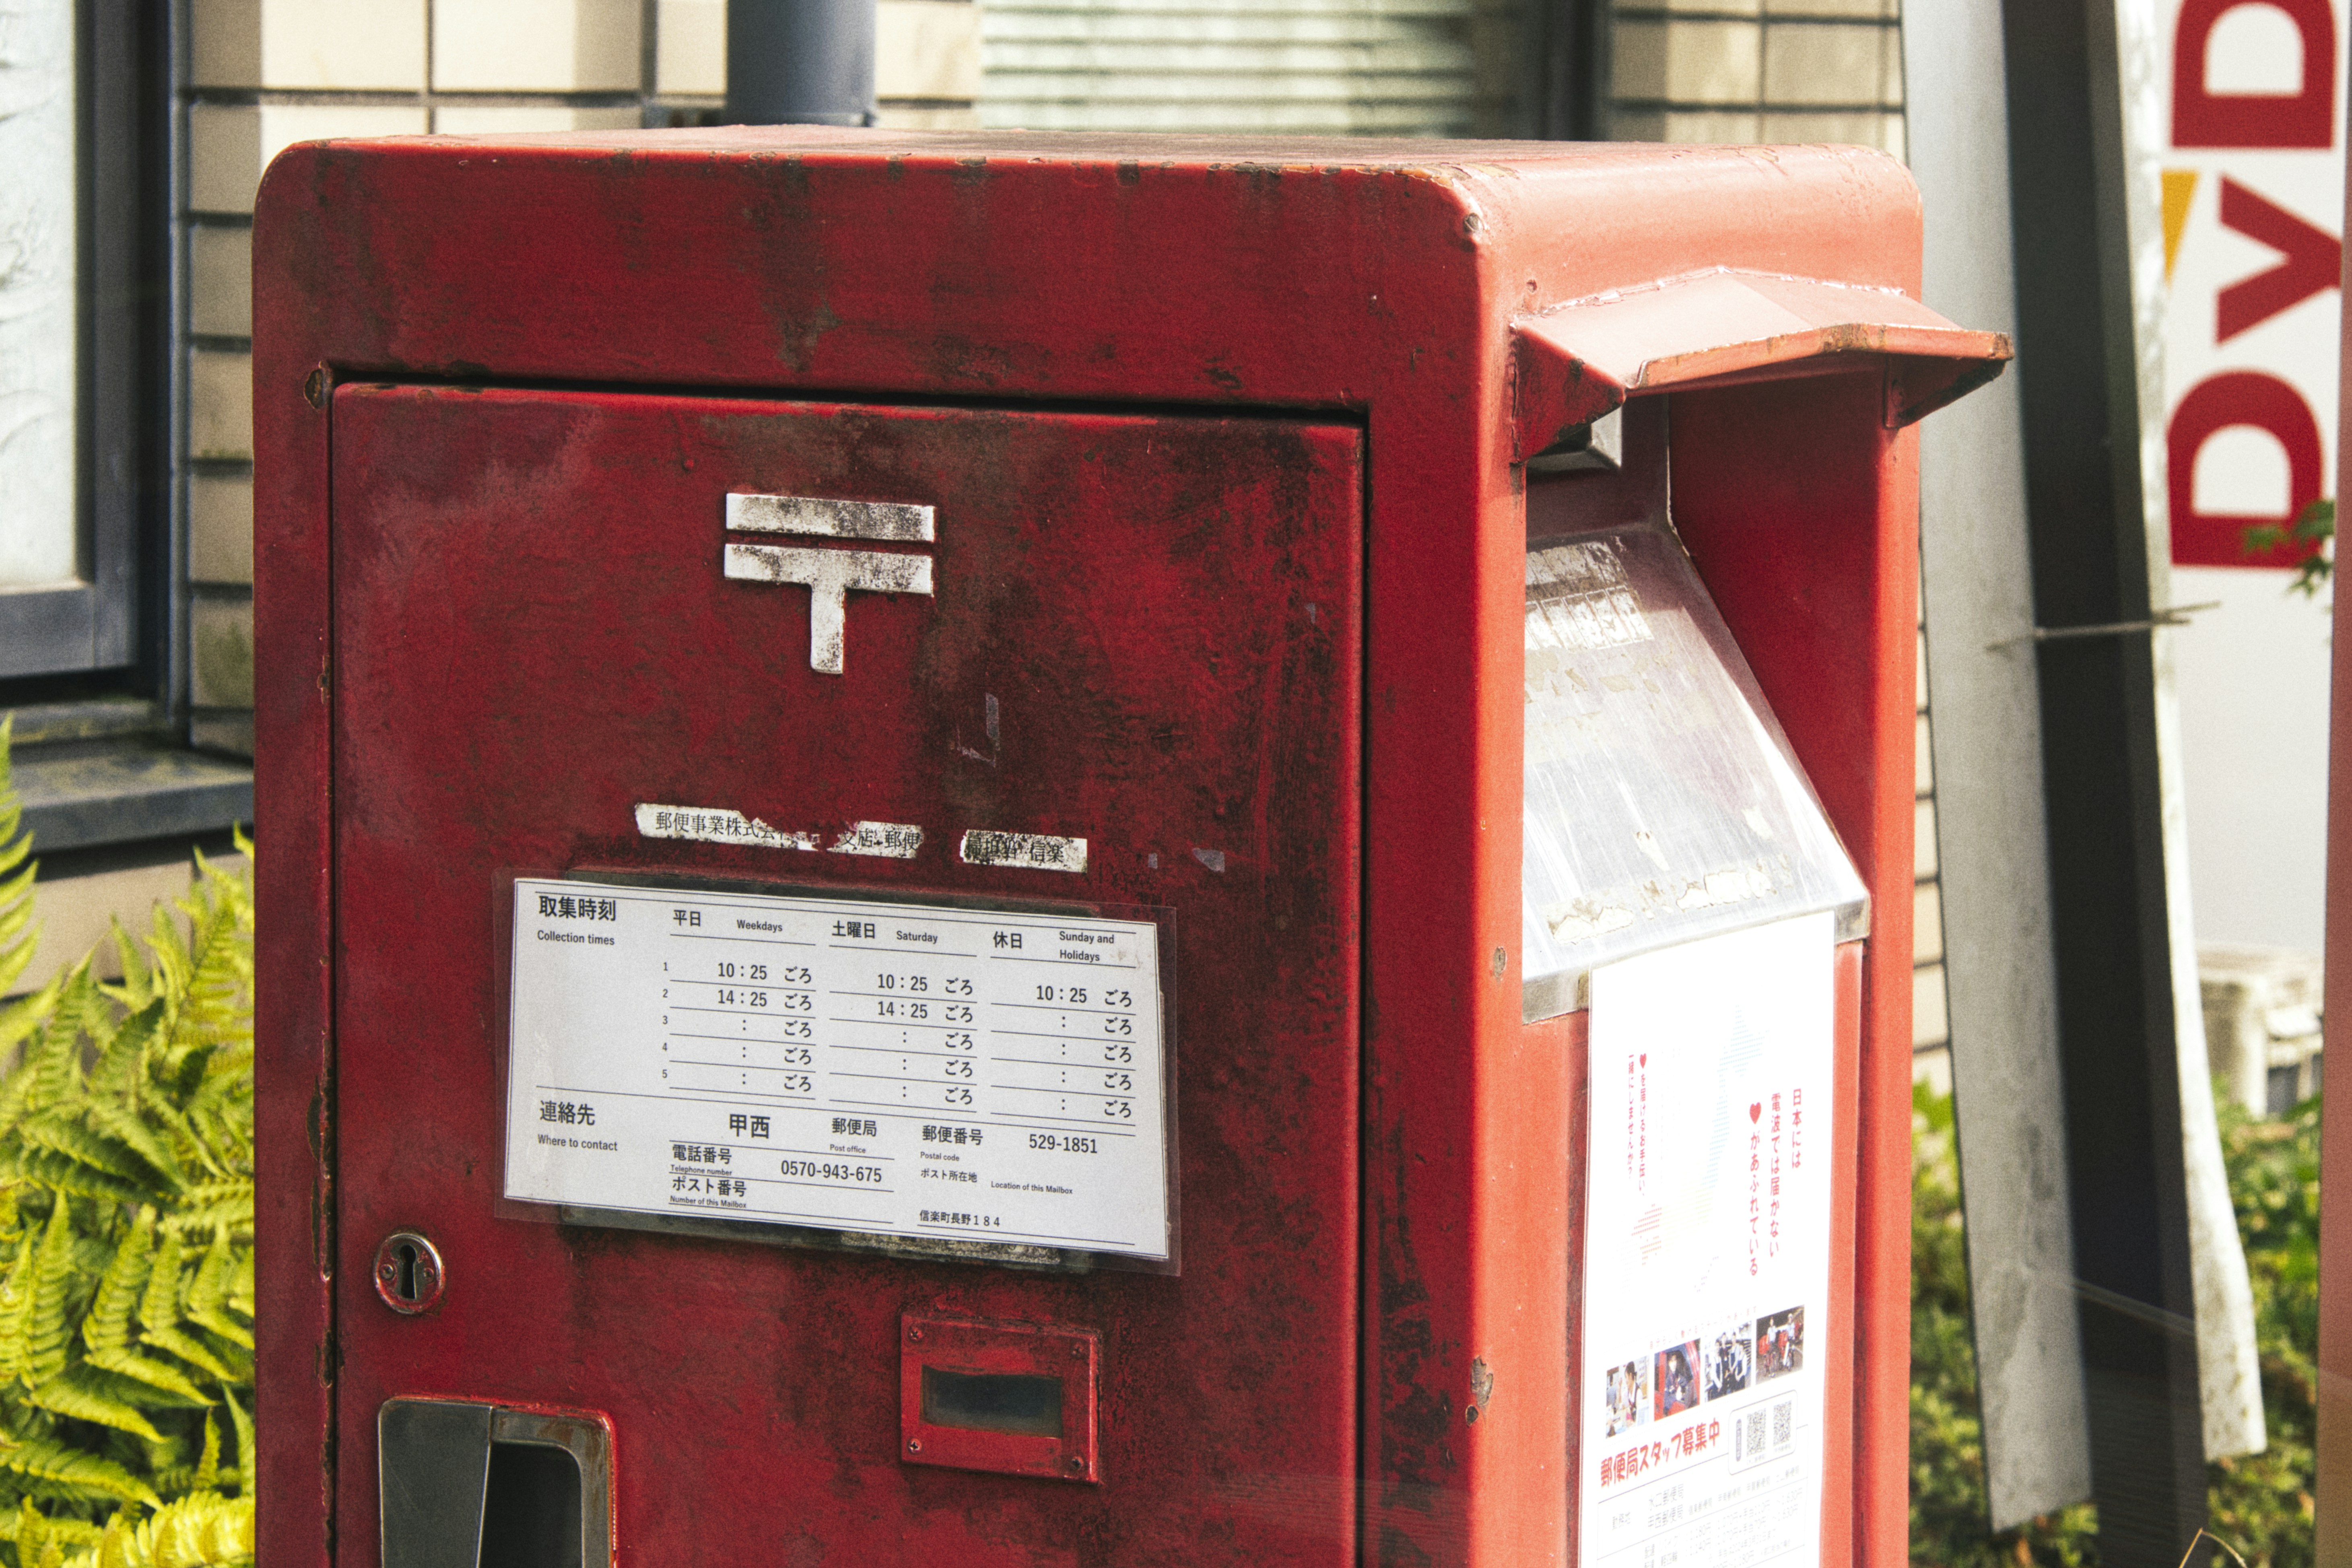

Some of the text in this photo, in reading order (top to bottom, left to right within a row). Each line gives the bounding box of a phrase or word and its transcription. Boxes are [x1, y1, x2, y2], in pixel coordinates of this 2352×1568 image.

[884, 829, 920, 851] 郵便
[1030, 842, 1064, 863] 信楽
[538, 895, 616, 921] 取集時刻
[673, 910, 701, 927] 平日
[737, 920, 783, 933] Weekdays
[537, 930, 614, 945] Collection times
[832, 920, 875, 939] 土曜日
[896, 930, 938, 944] Saturday
[1060, 931, 1114, 944] Sunday and
[993, 931, 1022, 949] 休日
[1060, 950, 1100, 963] Holidays
[664, 962, 811, 984] 1 10:25 ごろ
[878, 974, 973, 995] 10:25 ごろ
[663, 989, 811, 1011] 2 14:25 ごろ
[1037, 985, 1132, 1008] 10:25 ごろ
[878, 1001, 973, 1023] 14:25 ごろ
[663, 1016, 668, 1024] 3
[785, 1020, 811, 1038] ごろ
[1105, 1017, 1132, 1035] ごろ
[945, 1032, 973, 1050] ごろ
[784, 1047, 811, 1065] ごろ
[1105, 1045, 1132, 1063] ごろ
[945, 1060, 973, 1078] ごろ
[663, 1069, 667, 1078] 5
[784, 1074, 811, 1092] ごろ
[1105, 1072, 1132, 1091] ごろ
[945, 1087, 972, 1105] ごろ
[540, 1100, 595, 1126] 連絡先
[1104, 1100, 1131, 1118] ごろ
[729, 1114, 770, 1139] 甲西
[832, 1117, 877, 1137] 郵便局
[922, 1125, 983, 1146] 郵便番号
[1792, 1088, 1802, 1168] 日本には
[538, 1135, 617, 1151] Where to contact
[846, 1145, 866, 1154] office
[1029, 1134, 1097, 1154] 529-1851
[672, 1144, 732, 1165] 電話番号
[943, 1154, 960, 1162] code
[670, 1164, 733, 1177] Telephone number
[780, 1160, 882, 1183] 0570-943-675
[921, 1169, 977, 1183] ポスト所在地
[1770, 1092, 1781, 1257] 電波では届かない
[672, 1174, 747, 1197] ポスト番号
[991, 1181, 1021, 1190] Location
[1046, 1185, 1072, 1193] Mailbox
[670, 1195, 747, 1209] Number of this Mailbox
[1749, 1130, 1760, 1276] があふれている
[919, 1209, 1001, 1227] 信楽町長野184
[1601, 1417, 1720, 1488] 郵便局スタッフ募集中
